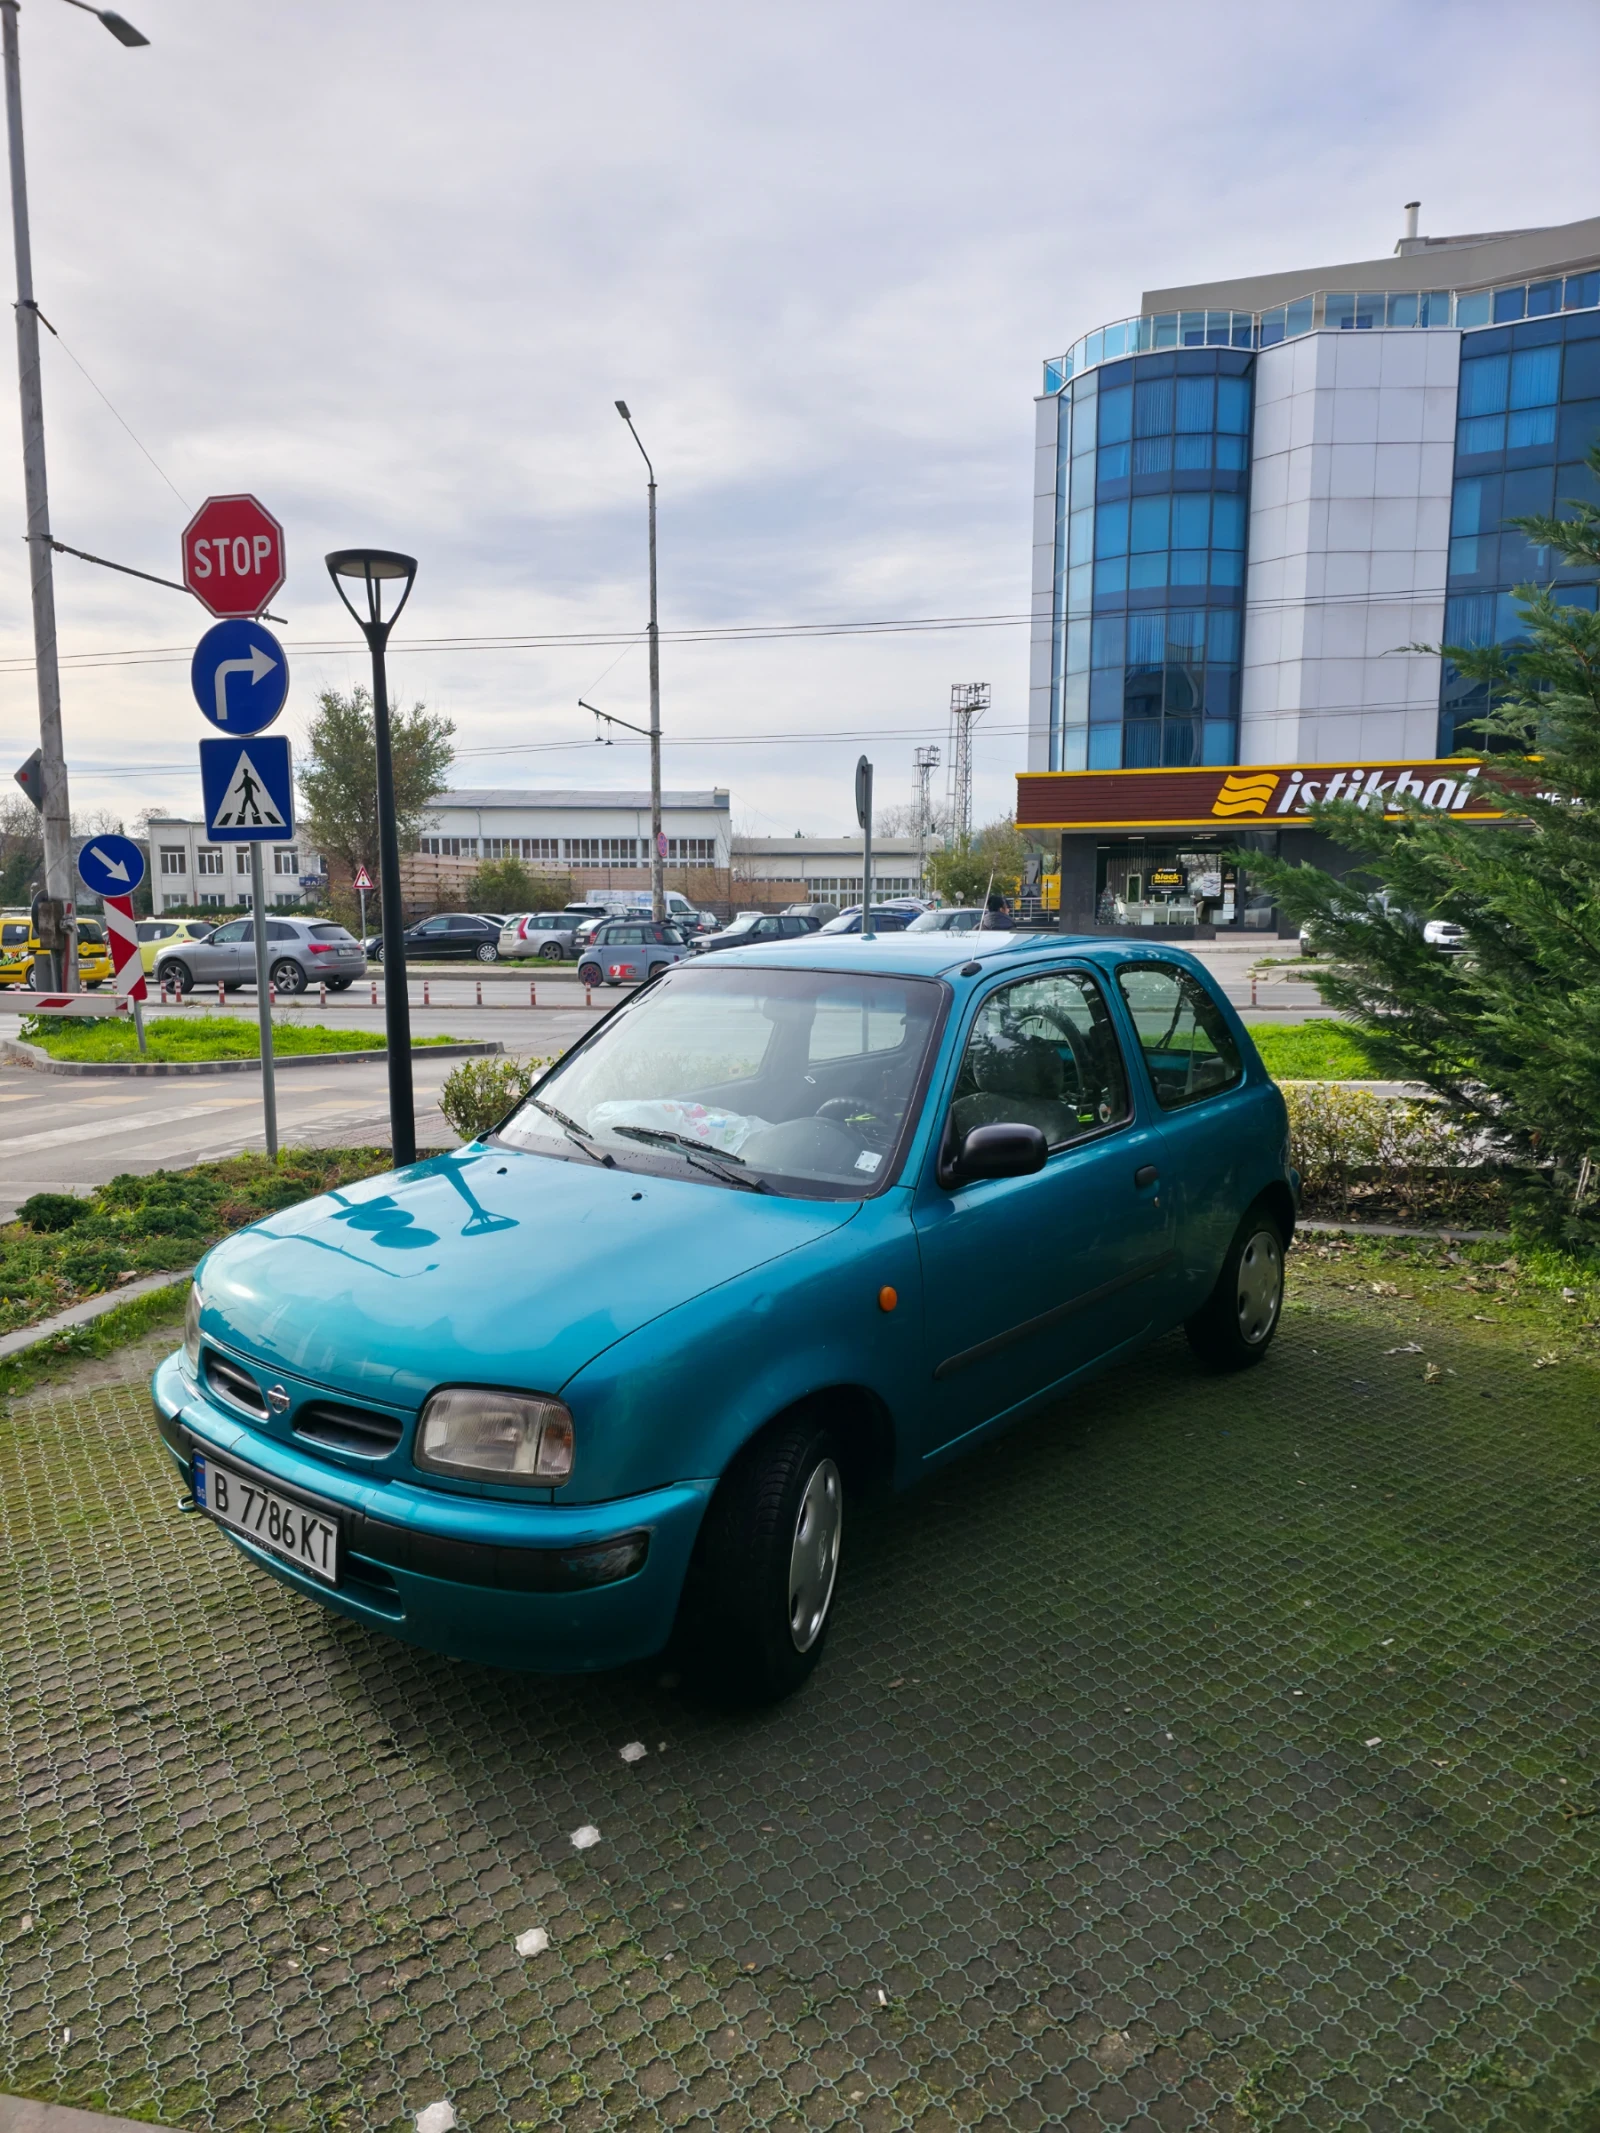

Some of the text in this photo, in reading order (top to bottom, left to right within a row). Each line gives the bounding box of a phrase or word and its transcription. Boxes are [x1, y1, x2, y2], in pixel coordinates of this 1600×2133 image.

[194, 535, 271, 578] STOP
[1276, 767, 1481, 814] istikbal
[196, 1486, 206, 1500] BG
[214, 1471, 229, 1512] B
